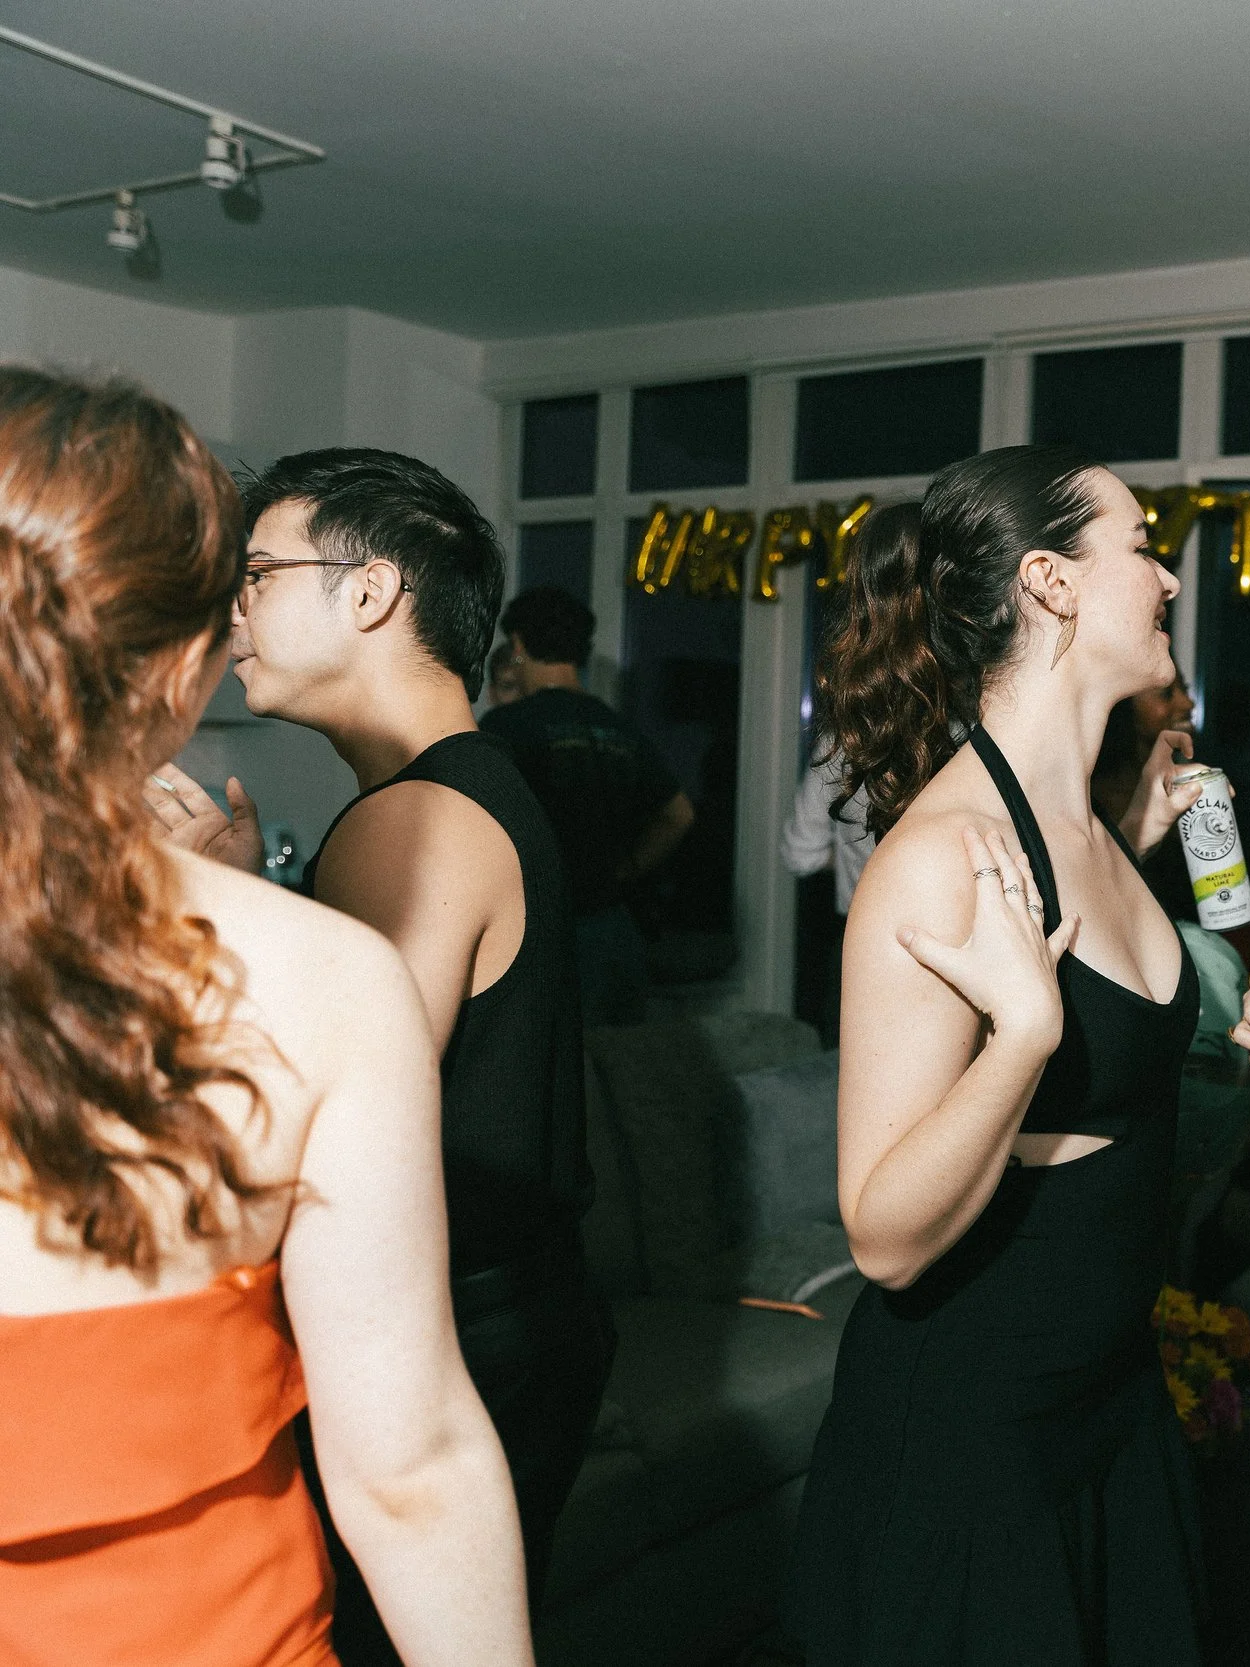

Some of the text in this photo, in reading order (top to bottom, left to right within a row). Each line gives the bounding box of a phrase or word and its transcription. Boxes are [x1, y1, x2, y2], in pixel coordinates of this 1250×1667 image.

[1196, 798, 1229, 812] CLAW
[1194, 847, 1217, 858] HARD
[1213, 879, 1229, 888] LIME
